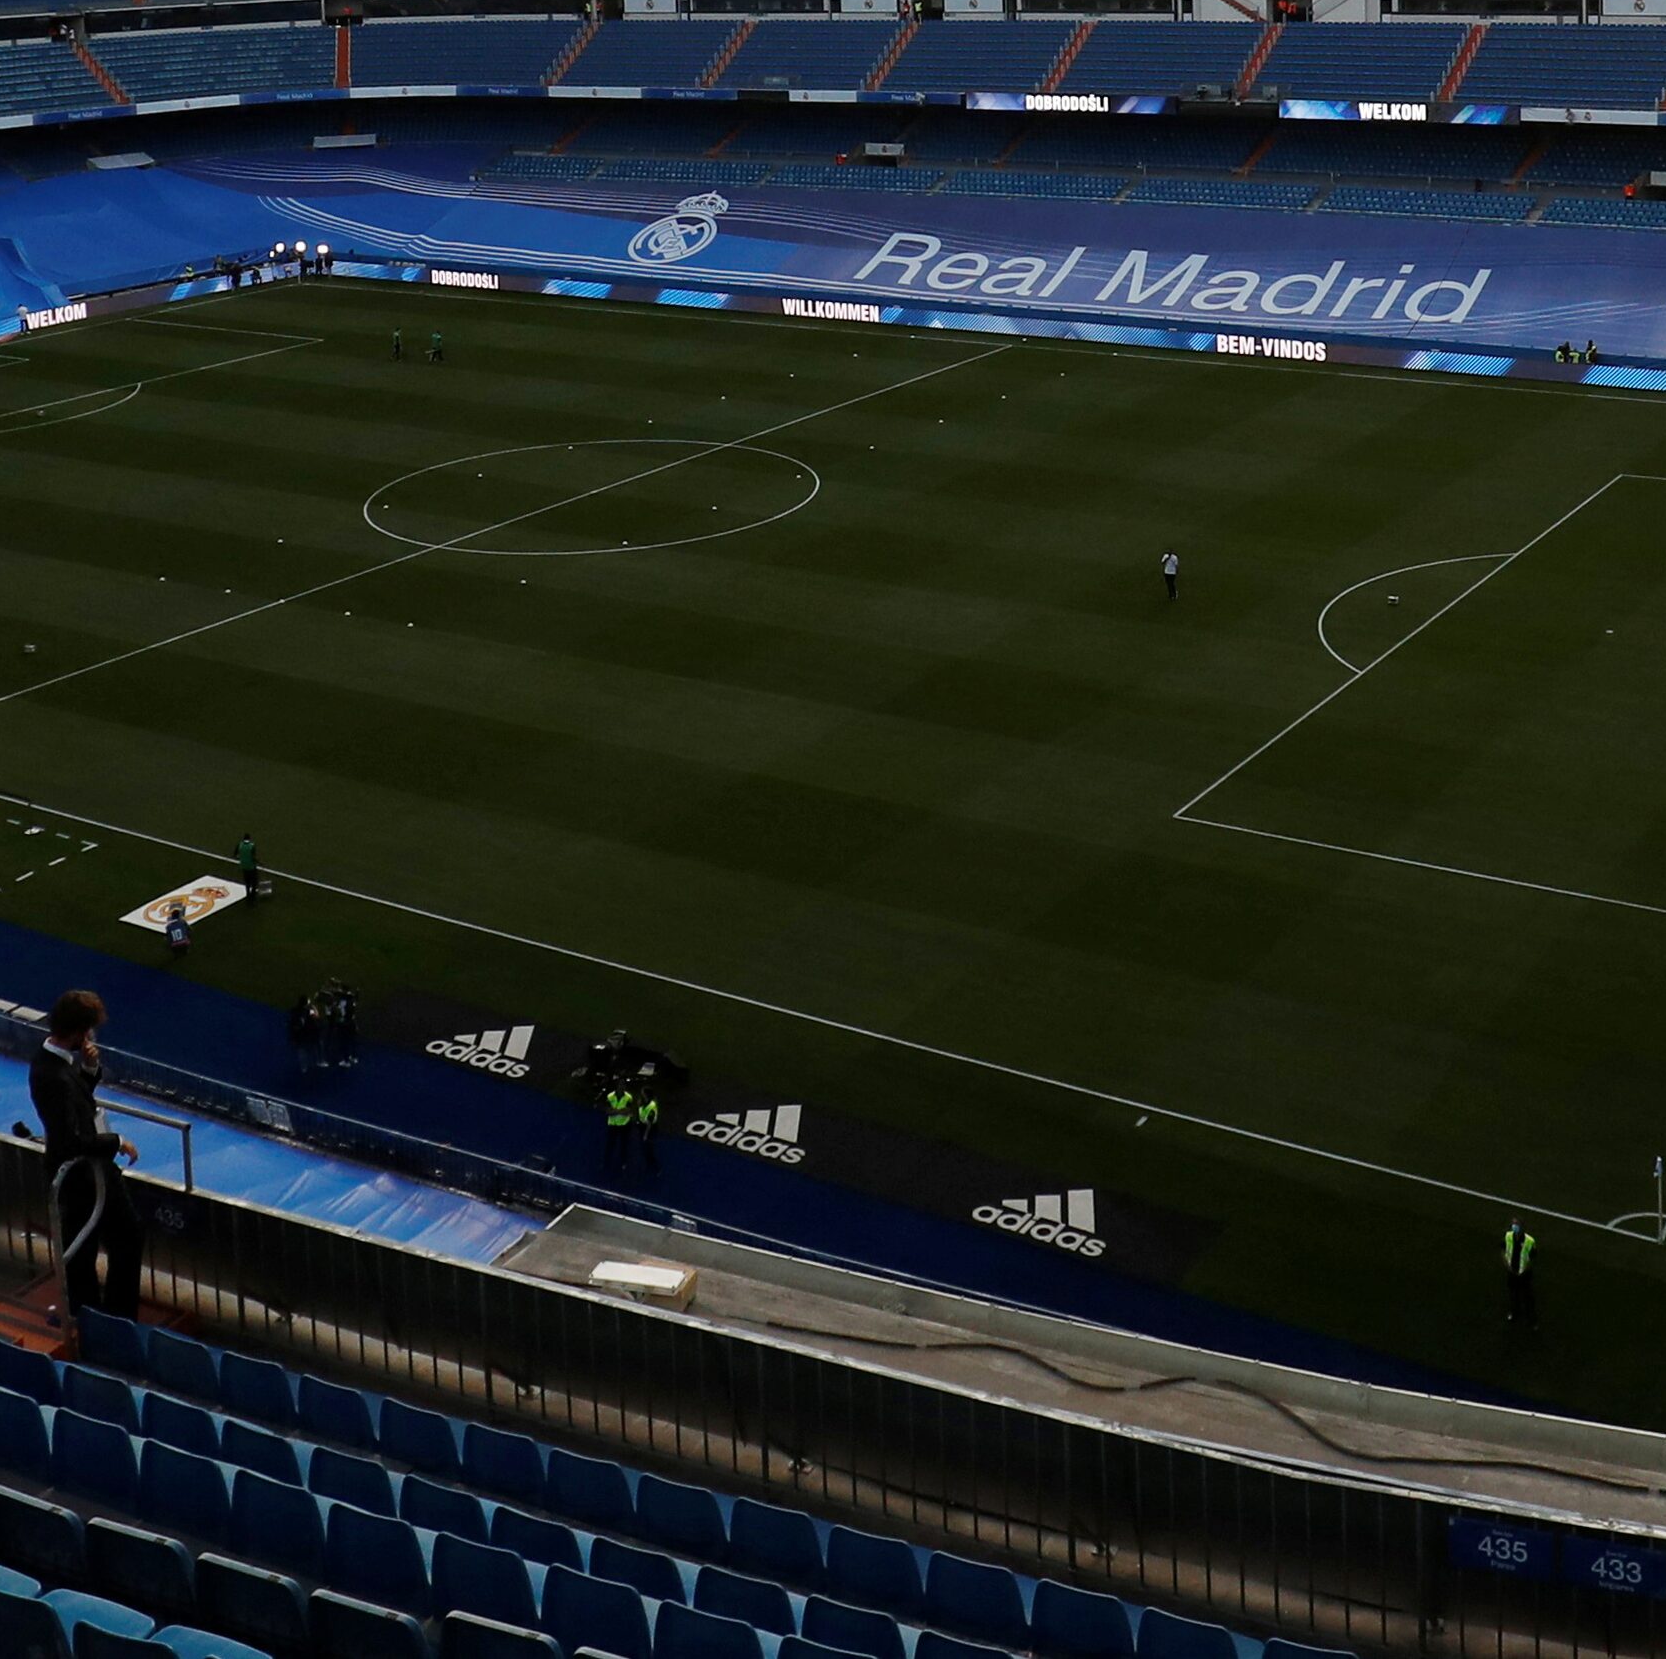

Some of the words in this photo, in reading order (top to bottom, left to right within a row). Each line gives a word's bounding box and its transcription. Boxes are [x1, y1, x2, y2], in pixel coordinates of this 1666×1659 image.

[1359, 102, 1426, 121] WELKOM
[854, 232, 1087, 298] Real
[1094, 248, 1491, 324] Madrid
[26, 302, 87, 330] WELKOM
[782, 298, 880, 323] WILLKOMMEN
[1215, 334, 1327, 362] BEM-VINDOS
[172, 928, 183, 941] 10
[425, 1040, 530, 1078] adidas
[686, 1120, 806, 1164] adidas
[972, 1206, 1107, 1257] adidas
[1477, 1536, 1528, 1563] 435
[1591, 1557, 1642, 1584] 433
